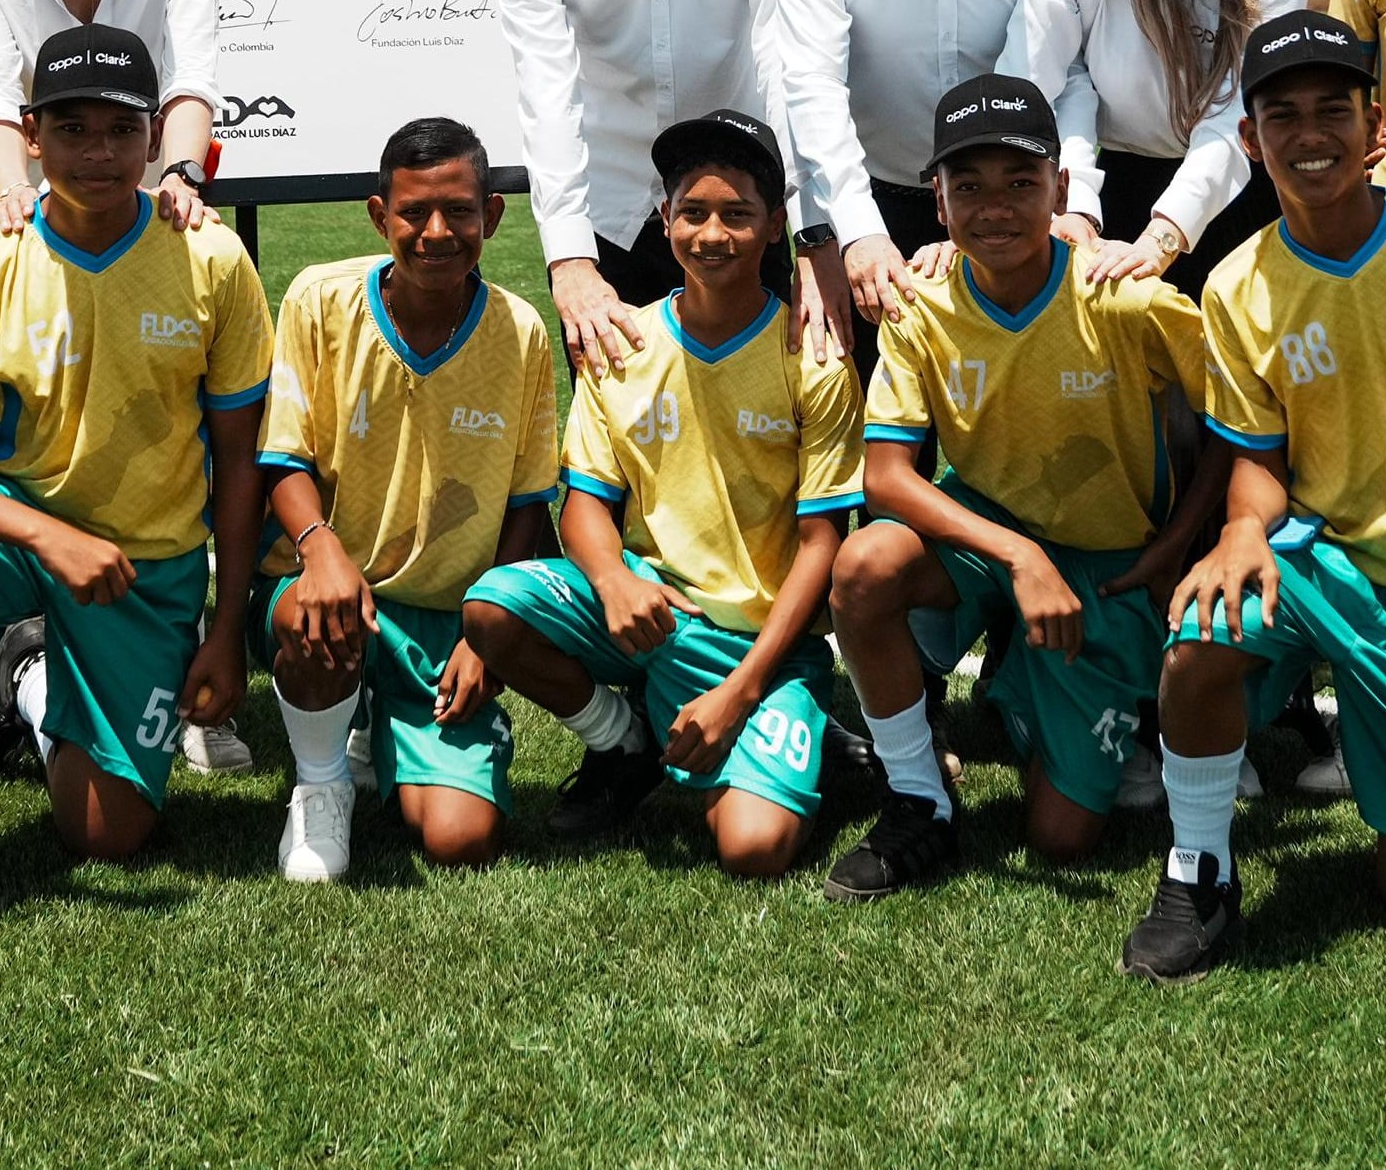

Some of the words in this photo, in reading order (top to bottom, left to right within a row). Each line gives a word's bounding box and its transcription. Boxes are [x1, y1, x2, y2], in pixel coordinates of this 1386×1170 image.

[228, 42, 275, 53] Colombia
[371, 37, 421, 49] Fundación
[422, 37, 443, 47] Luis
[1261, 33, 1301, 53] oppo
[48, 55, 83, 72] oppo
[95, 52, 126, 66] Claro
[946, 104, 979, 123] oppo
[991, 99, 1021, 111] Claro
[213, 127, 247, 140] ACIÓN
[248, 128, 271, 139] LUIS
[272, 126, 297, 138] DÍAZ
[140, 313, 175, 338] FLD
[1280, 321, 1337, 384] 88
[451, 406, 483, 428] FLD
[634, 391, 680, 445] 99
[737, 408, 771, 434] FLD
[755, 708, 811, 773] 99
